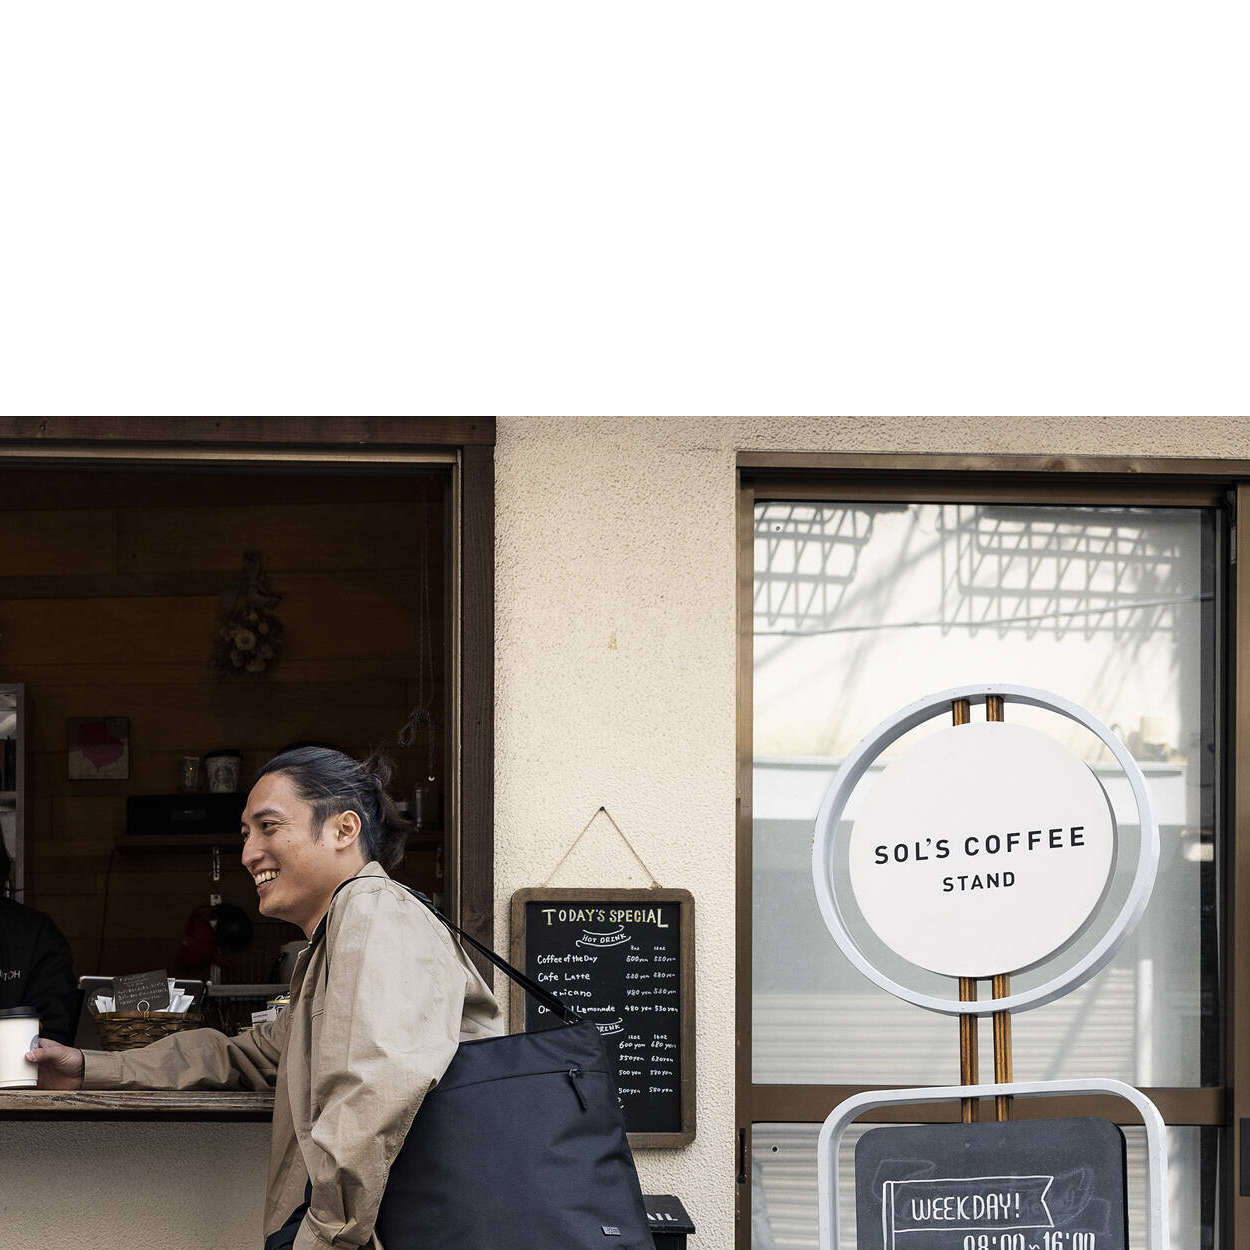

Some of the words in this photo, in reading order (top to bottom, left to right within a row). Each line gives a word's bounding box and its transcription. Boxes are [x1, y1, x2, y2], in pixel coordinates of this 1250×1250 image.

[874, 837, 950, 865] SOL'S
[964, 826, 1086, 857] COFFEE
[942, 871, 1016, 893] STAND
[541, 908, 606, 926] TODAY'S
[609, 908, 669, 928] SPECIAL
[582, 934, 597, 943] HOT
[599, 933, 627, 944] DRINK
[537, 954, 562, 965] Coffee
[563, 953, 571, 963] of
[572, 954, 584, 963] the
[583, 954, 598, 964] Day
[537, 972, 559, 982] Cafe
[564, 972, 591, 981] Latte
[551, 988, 592, 998] ericano
[576, 1004, 616, 1014] Lemonade
[911, 1192, 1021, 1222] WEEKDAY!
